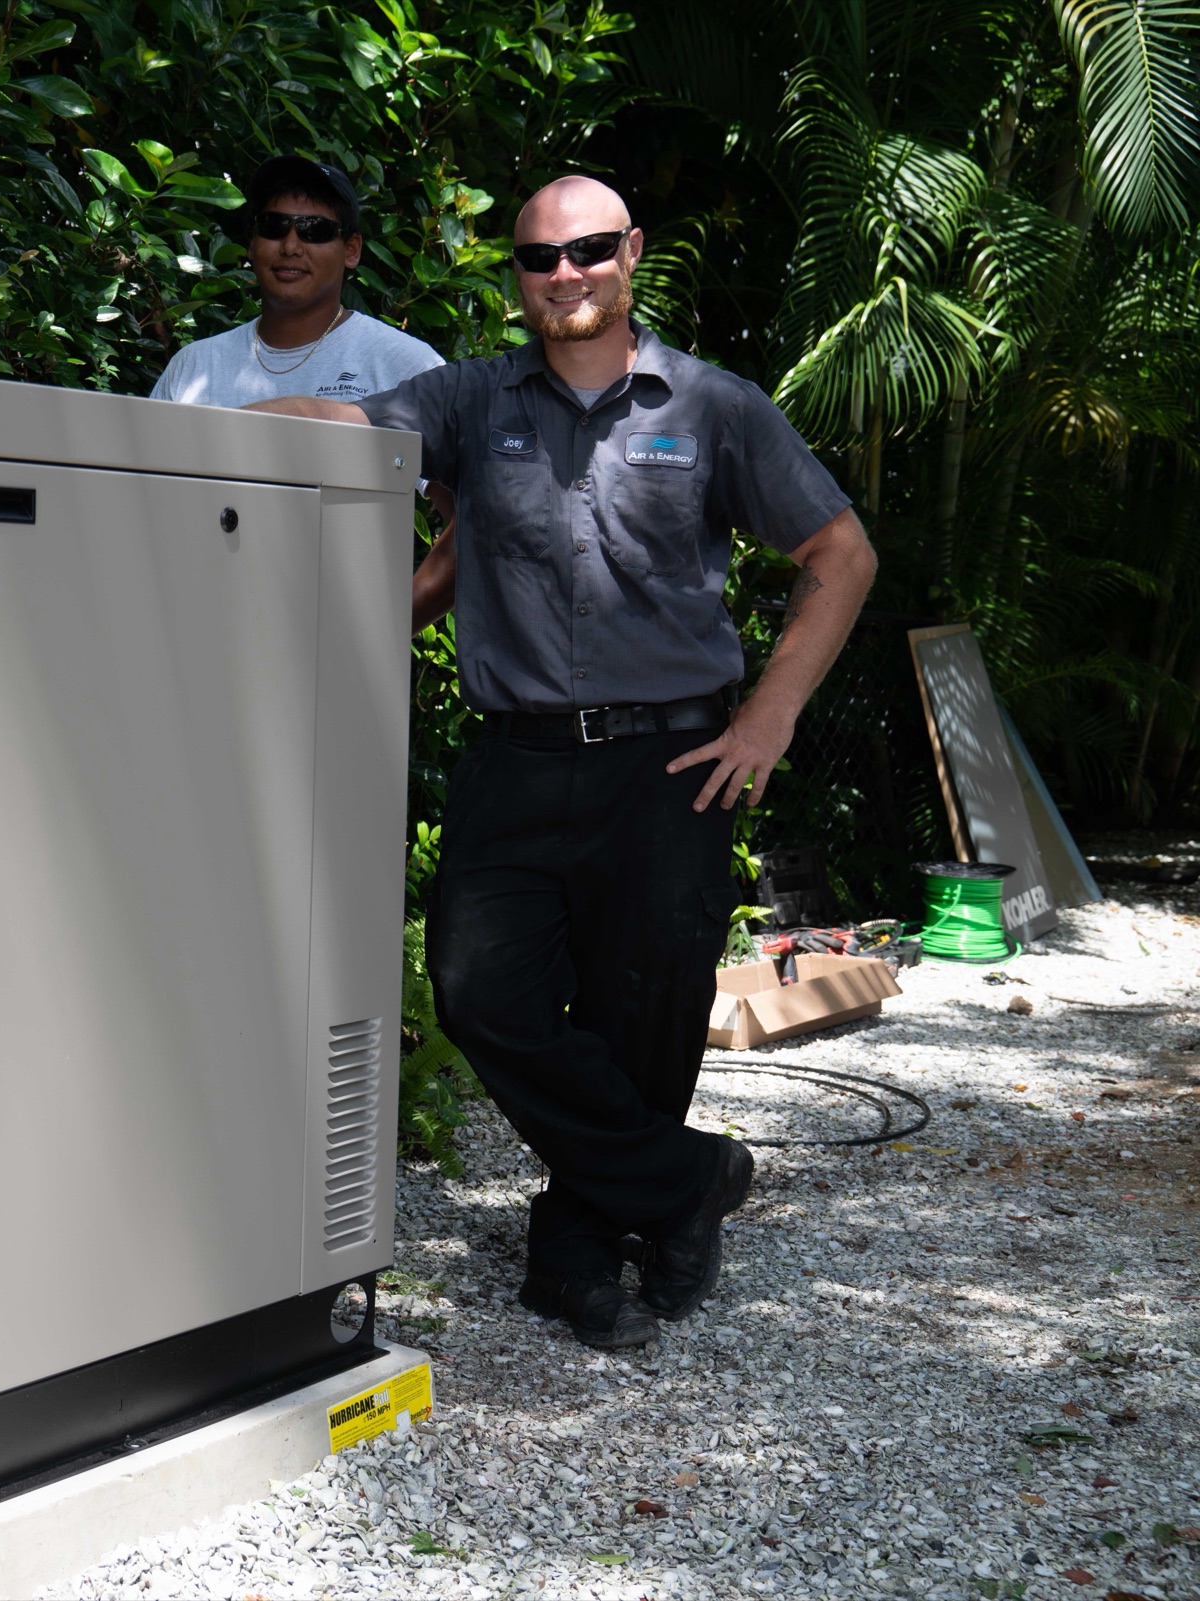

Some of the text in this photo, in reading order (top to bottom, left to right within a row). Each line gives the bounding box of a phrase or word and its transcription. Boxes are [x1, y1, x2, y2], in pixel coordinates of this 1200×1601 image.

[339, 384, 368, 394] ENERGY
[504, 437, 524, 450] Joey
[628, 452, 646, 460] AIR
[657, 452, 693, 464] ENERGY
[1002, 885, 1052, 931] KOHLER
[366, 1410, 377, 1422] 150
[377, 1402, 390, 1416] MPH
